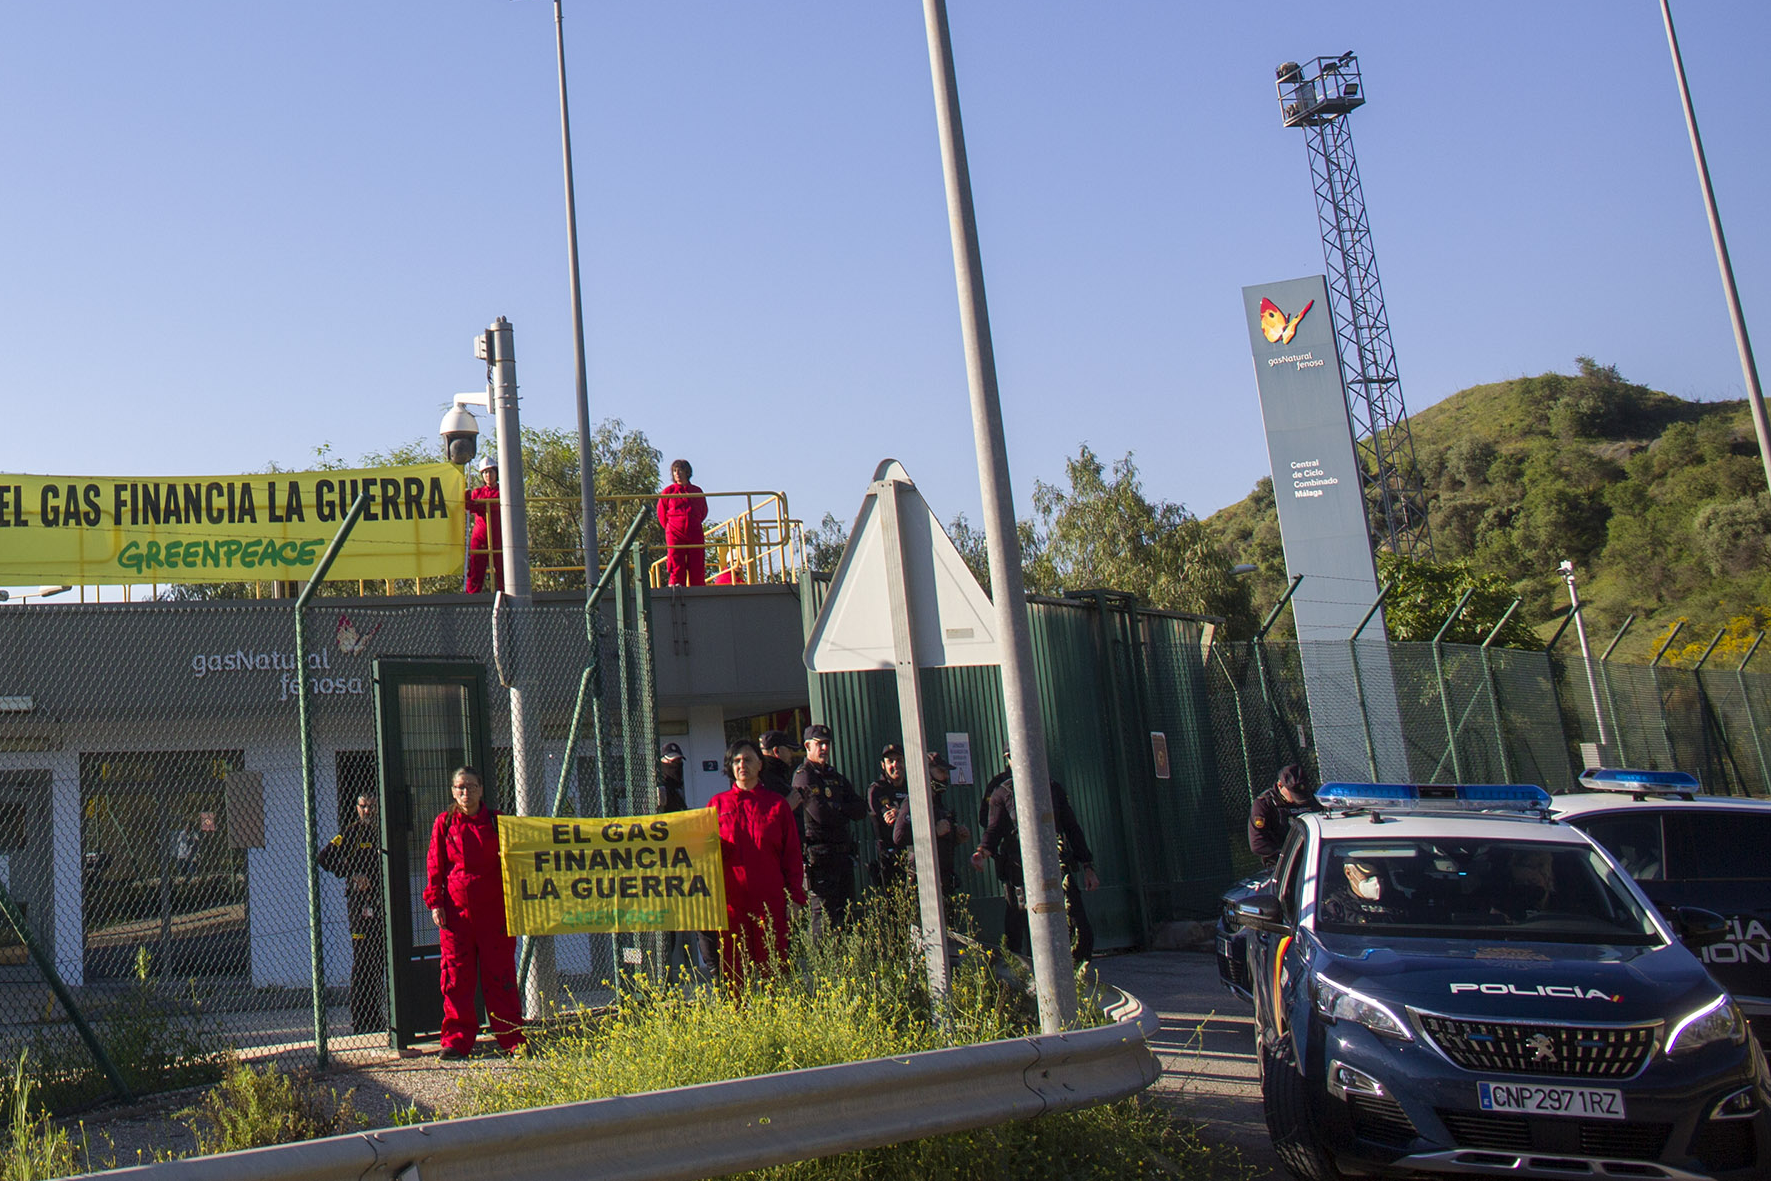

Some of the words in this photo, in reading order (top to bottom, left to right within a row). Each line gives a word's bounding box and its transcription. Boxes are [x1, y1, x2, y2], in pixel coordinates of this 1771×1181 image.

[1268, 352, 1313, 368] gasNatural
[1297, 359, 1324, 371] fenosa
[1290, 459, 1319, 469] Central
[1292, 470, 1302, 479] de
[1304, 468, 1324, 477] Ciclo
[1294, 477, 1338, 488] Combinado
[40, 484, 101, 527] GAS
[114, 481, 257, 525] FINANCIA
[268, 481, 305, 523] LA
[315, 476, 448, 522] GUERRA
[1295, 488, 1323, 499] Málaga
[117, 538, 325, 574] GREENPEACE
[192, 647, 330, 677] gasNatual
[552, 824, 591, 844] EL
[602, 821, 669, 842] GAS
[534, 847, 692, 872] FINANCIA
[521, 878, 561, 900] LA
[571, 875, 711, 899] GUERRA
[561, 909, 670, 928] GREENPEACE
[1450, 983, 1612, 1001] POLICÍA
